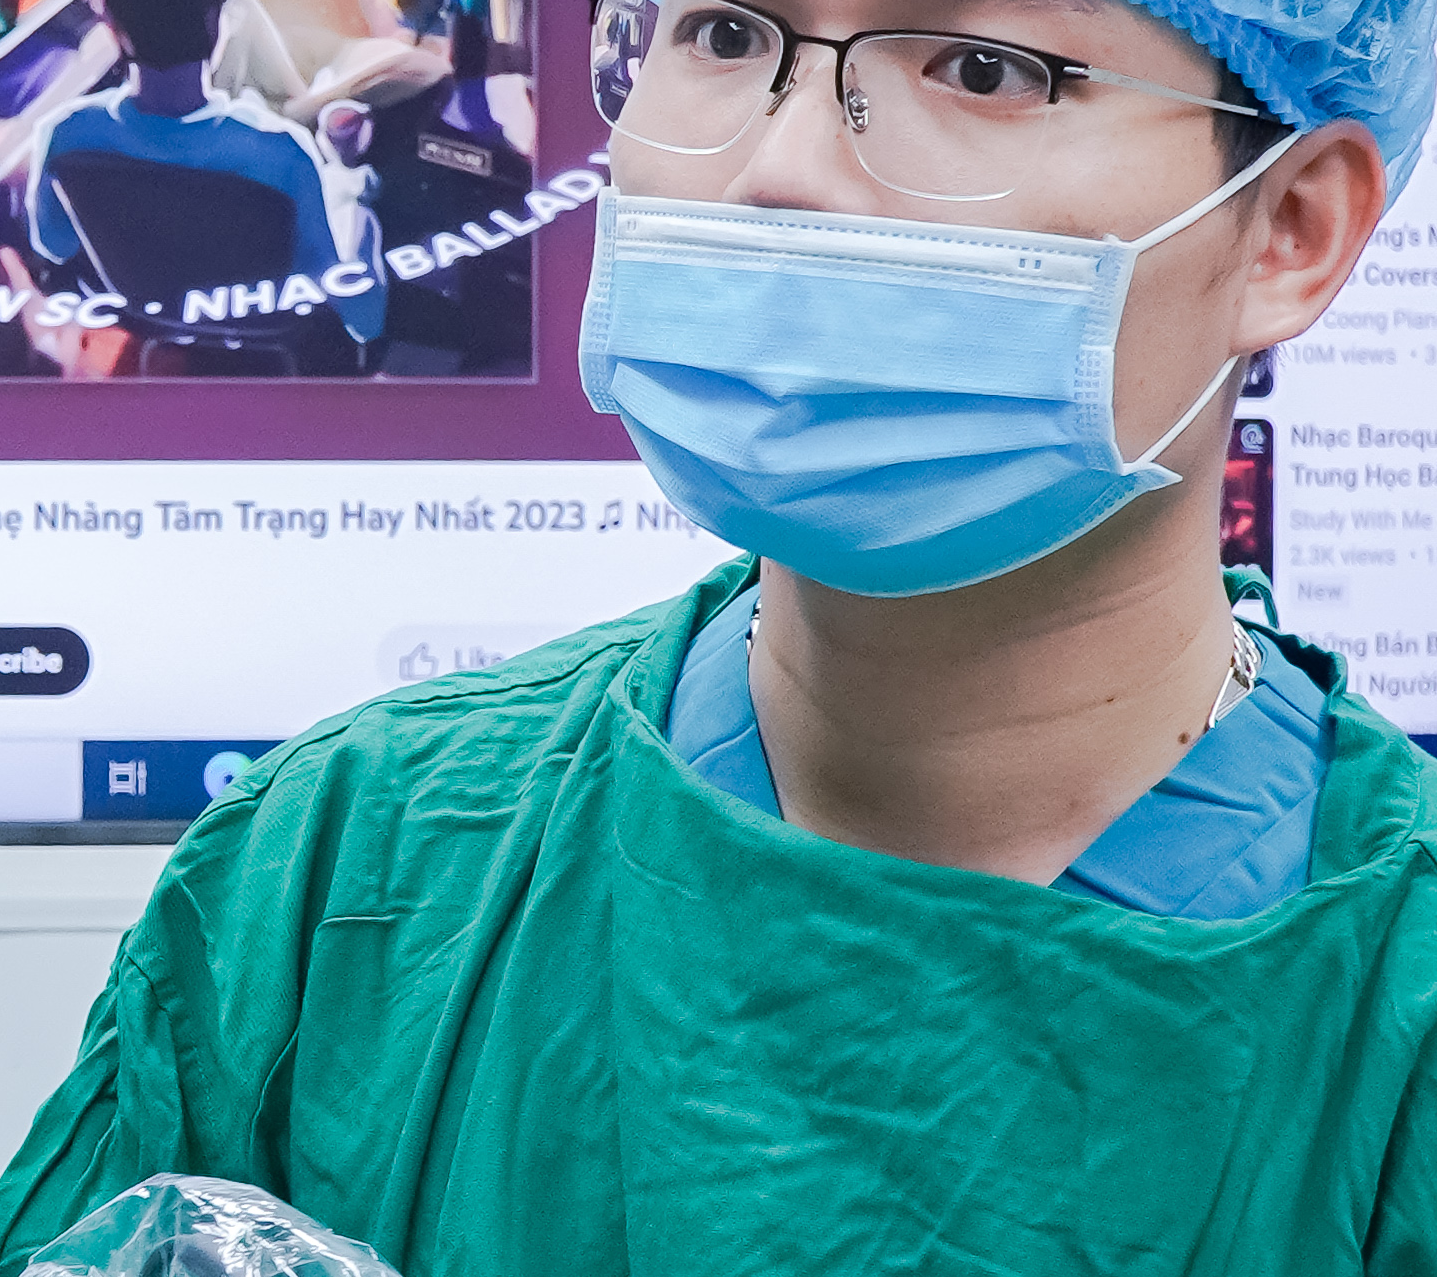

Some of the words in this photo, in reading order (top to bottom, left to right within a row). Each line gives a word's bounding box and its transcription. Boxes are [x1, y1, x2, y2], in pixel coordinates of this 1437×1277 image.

[35, 292, 127, 328] SC
[182, 260, 374, 323] NHẠC
[385, 169, 604, 280] BALLAD
[1341, 345, 1397, 365] views
[1290, 424, 1352, 452] Nhạc
[1290, 462, 1358, 491] Trung
[234, 501, 327, 538] Trạng
[339, 501, 404, 537] Hay
[414, 494, 495, 532] Nhất
[504, 499, 585, 532] 2023
[1289, 509, 1345, 535] Study
[1350, 509, 1396, 530] With
[1401, 510, 1433, 530] Me
[1341, 545, 1396, 566] views
[1297, 581, 1343, 602] New
